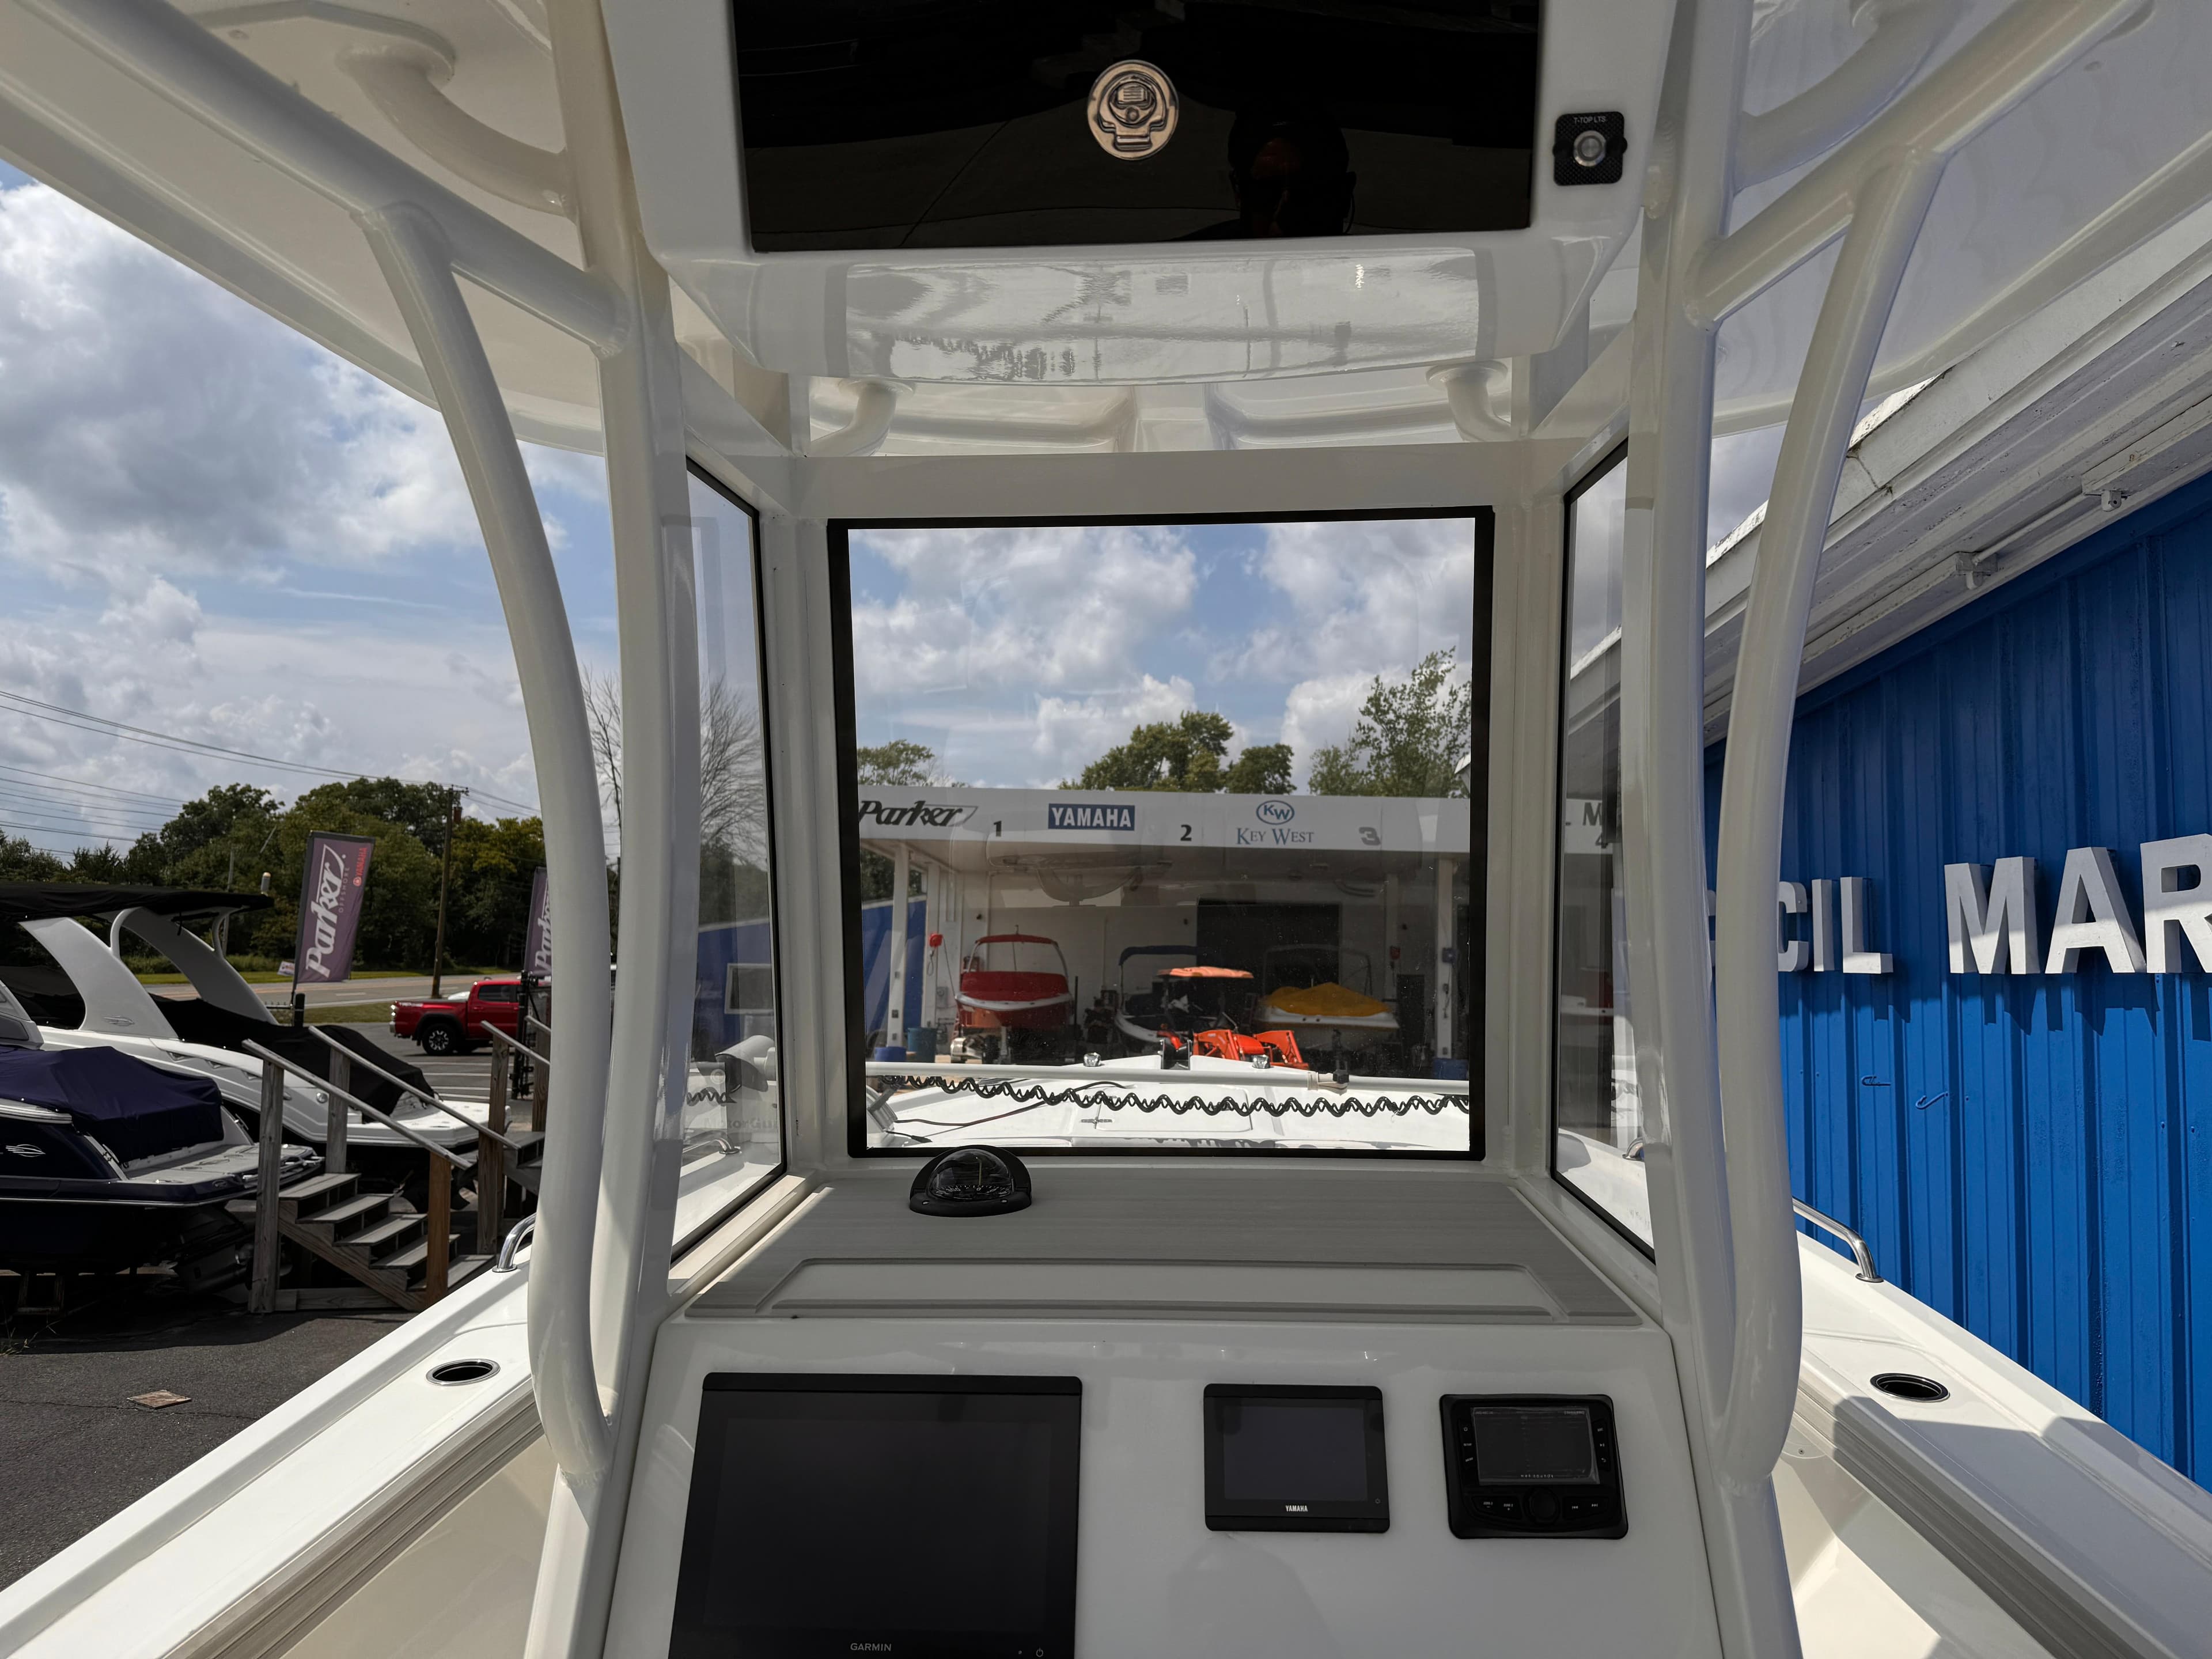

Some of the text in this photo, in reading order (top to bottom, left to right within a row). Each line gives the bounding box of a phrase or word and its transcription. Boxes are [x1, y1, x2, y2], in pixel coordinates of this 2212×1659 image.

[858, 800, 963, 827] Parker
[1051, 808, 1132, 827] YAMAHA
[1263, 804, 1290, 820] KW
[994, 821, 1002, 837] 1
[1180, 825, 1192, 842] 2
[1359, 827, 1381, 846] 3
[355, 847, 367, 876] YAMAHA
[338, 867, 351, 914] OFFSHORE
[1944, 834, 2212, 974] MAR
[306, 862, 342, 978] Parker
[535, 893, 552, 974] Park
[850, 1642, 892, 1652] GARMIN
